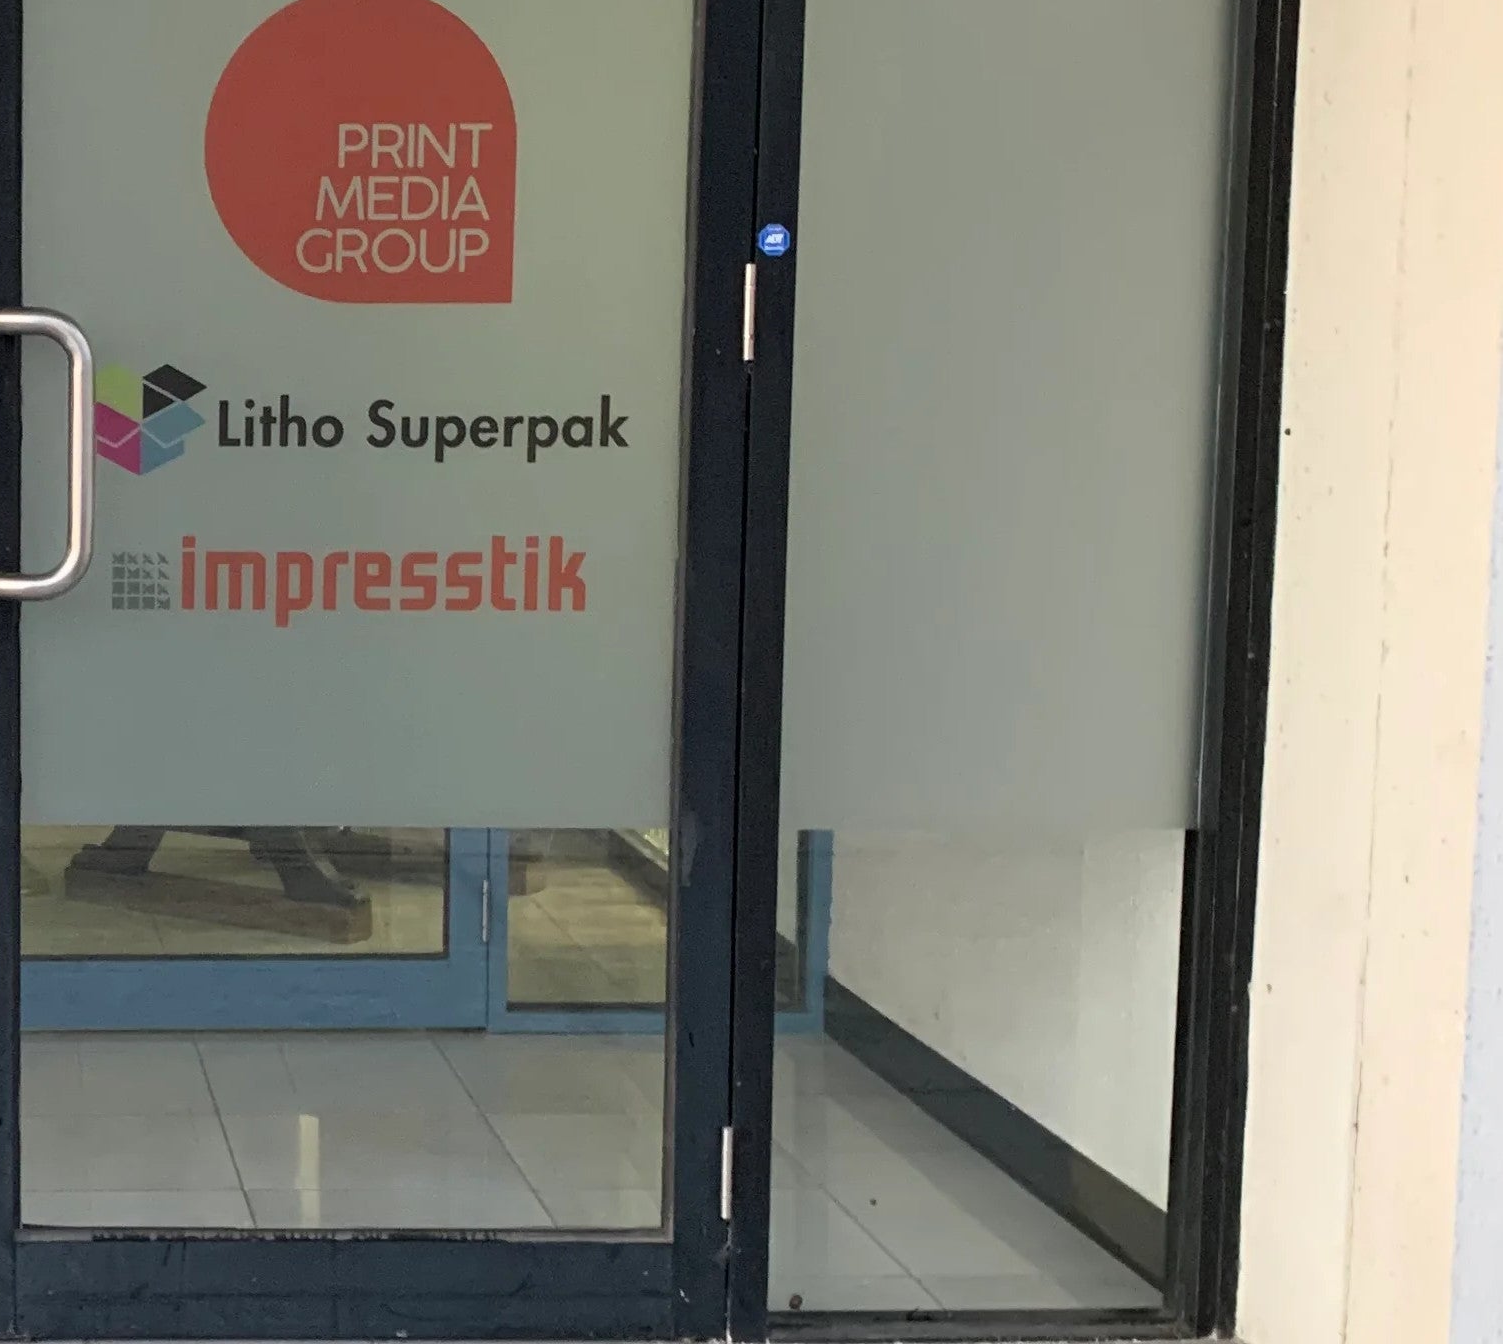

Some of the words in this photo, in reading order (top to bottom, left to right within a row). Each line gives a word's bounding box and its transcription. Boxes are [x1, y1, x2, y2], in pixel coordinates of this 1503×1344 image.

[338, 123, 492, 169] PRINT
[314, 176, 490, 222] MEDIA
[296, 227, 489, 274] GROUP
[218, 394, 344, 448] Litho
[366, 394, 629, 463] Superpak
[181, 535, 586, 627] impresstik
